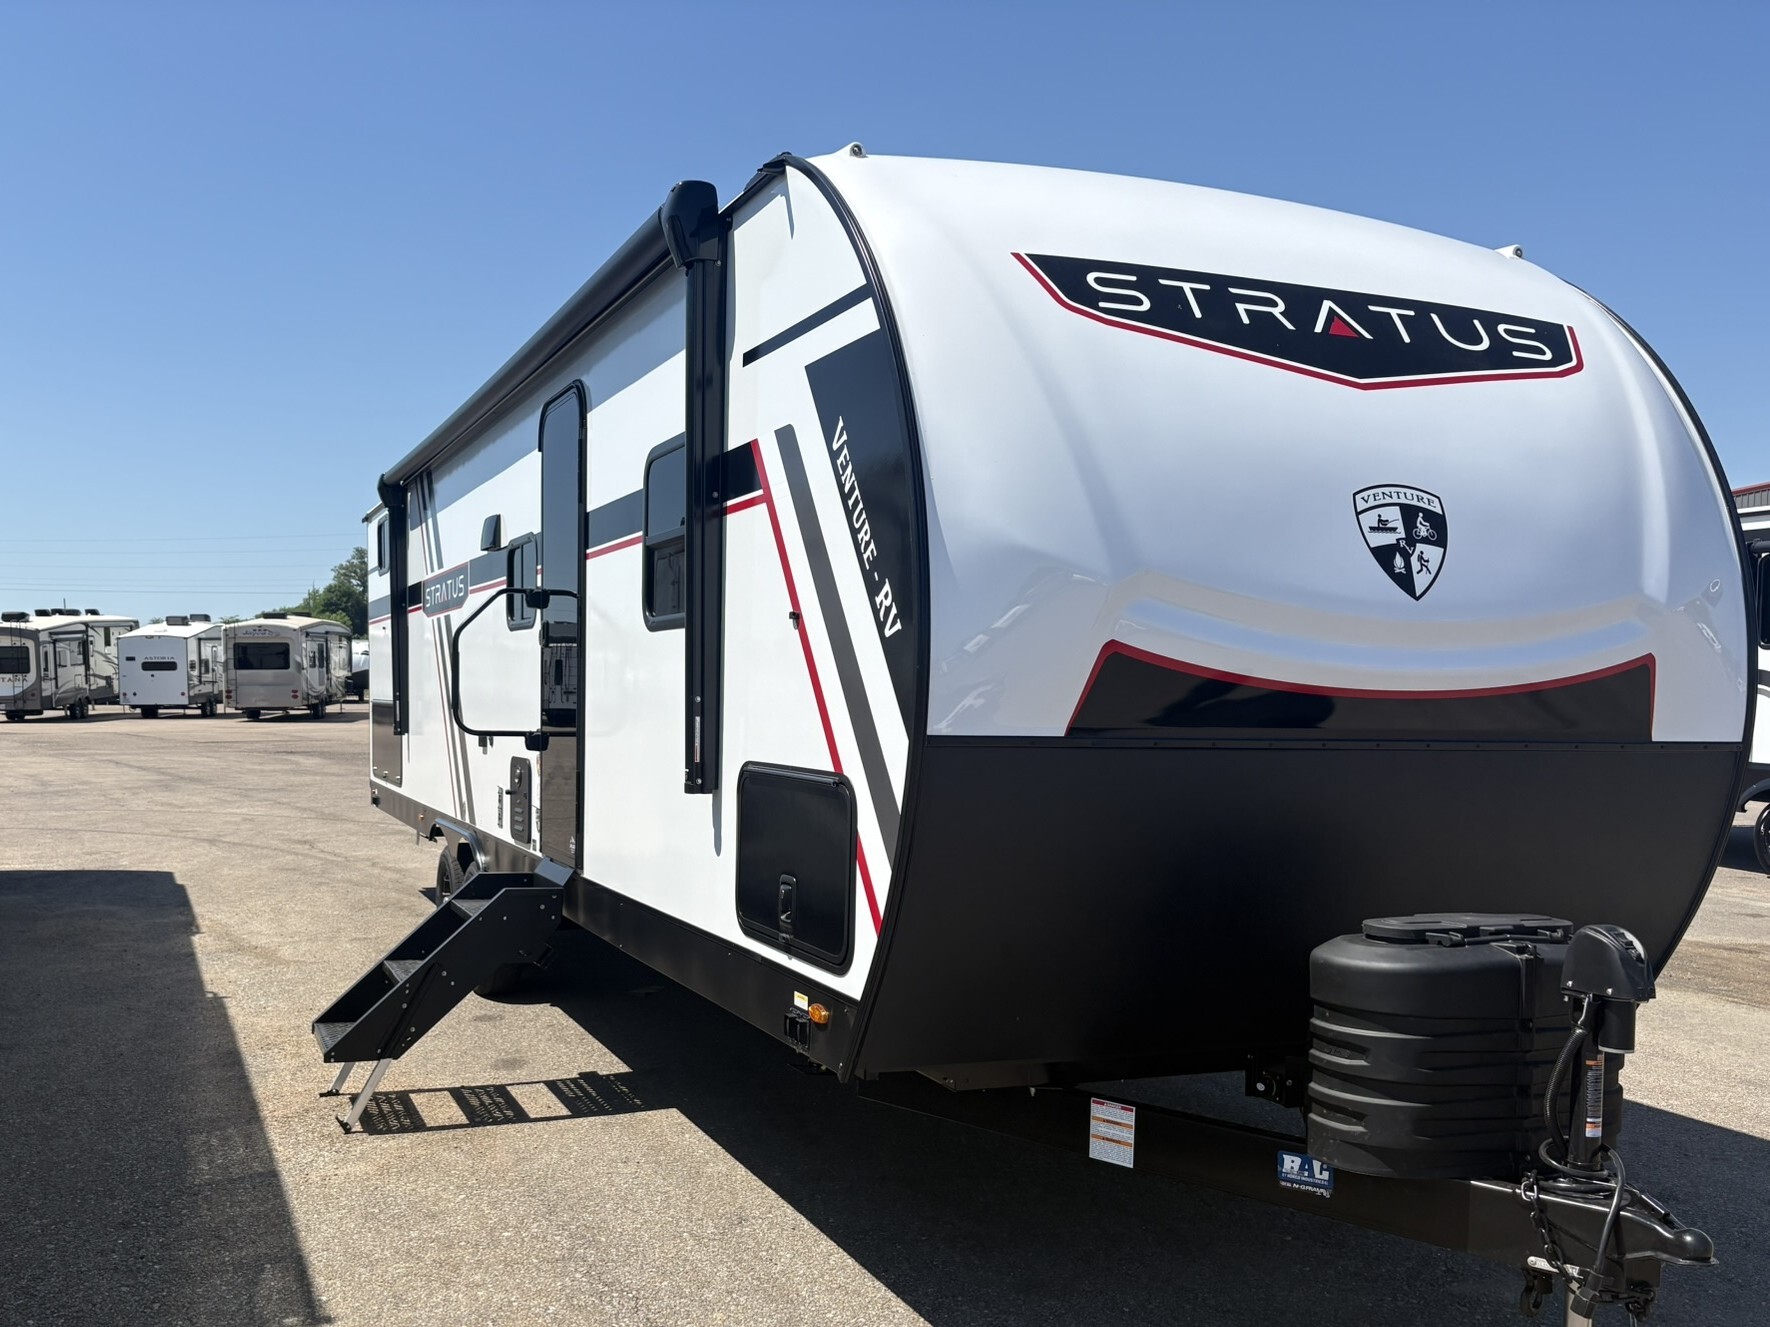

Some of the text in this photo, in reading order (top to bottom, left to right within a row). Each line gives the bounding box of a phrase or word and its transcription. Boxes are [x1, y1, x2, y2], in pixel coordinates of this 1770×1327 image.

[1086, 271, 1553, 361] STRATUS
[1360, 490, 1437, 509] VENTURE
[832, 415, 877, 570] VENTURE
[875, 578, 902, 638] RV
[1399, 539, 1415, 555] RV
[425, 574, 465, 608] STRATUS
